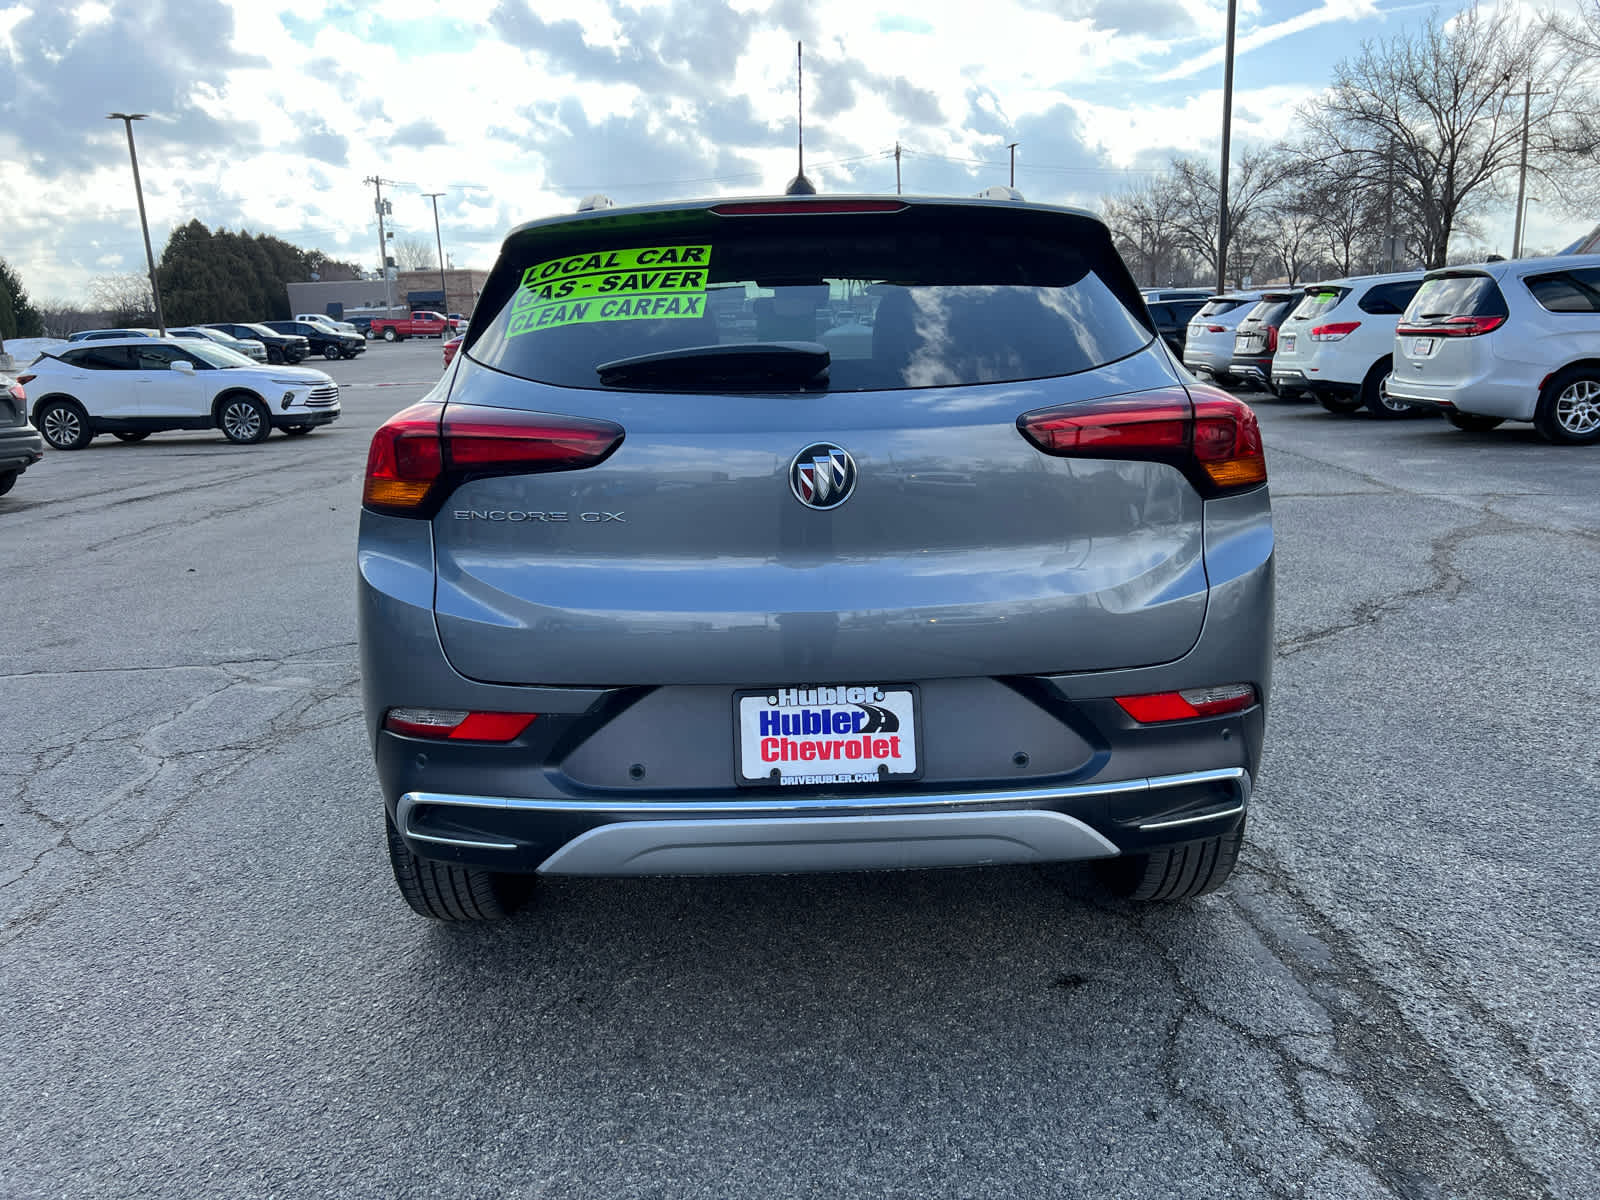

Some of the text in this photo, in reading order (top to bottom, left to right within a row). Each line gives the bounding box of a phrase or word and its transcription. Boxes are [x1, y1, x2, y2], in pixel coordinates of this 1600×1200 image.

[523, 247, 705, 285] LOCAL CAR
[510, 296, 702, 333] CLEAN CARFAX
[453, 510, 626, 522] ENCORE GX
[778, 686, 879, 707] Hubler
[760, 709, 866, 737] Hubler
[761, 735, 902, 762] Chevrolet
[780, 773, 880, 786] DRIVEHUBLER.COM
